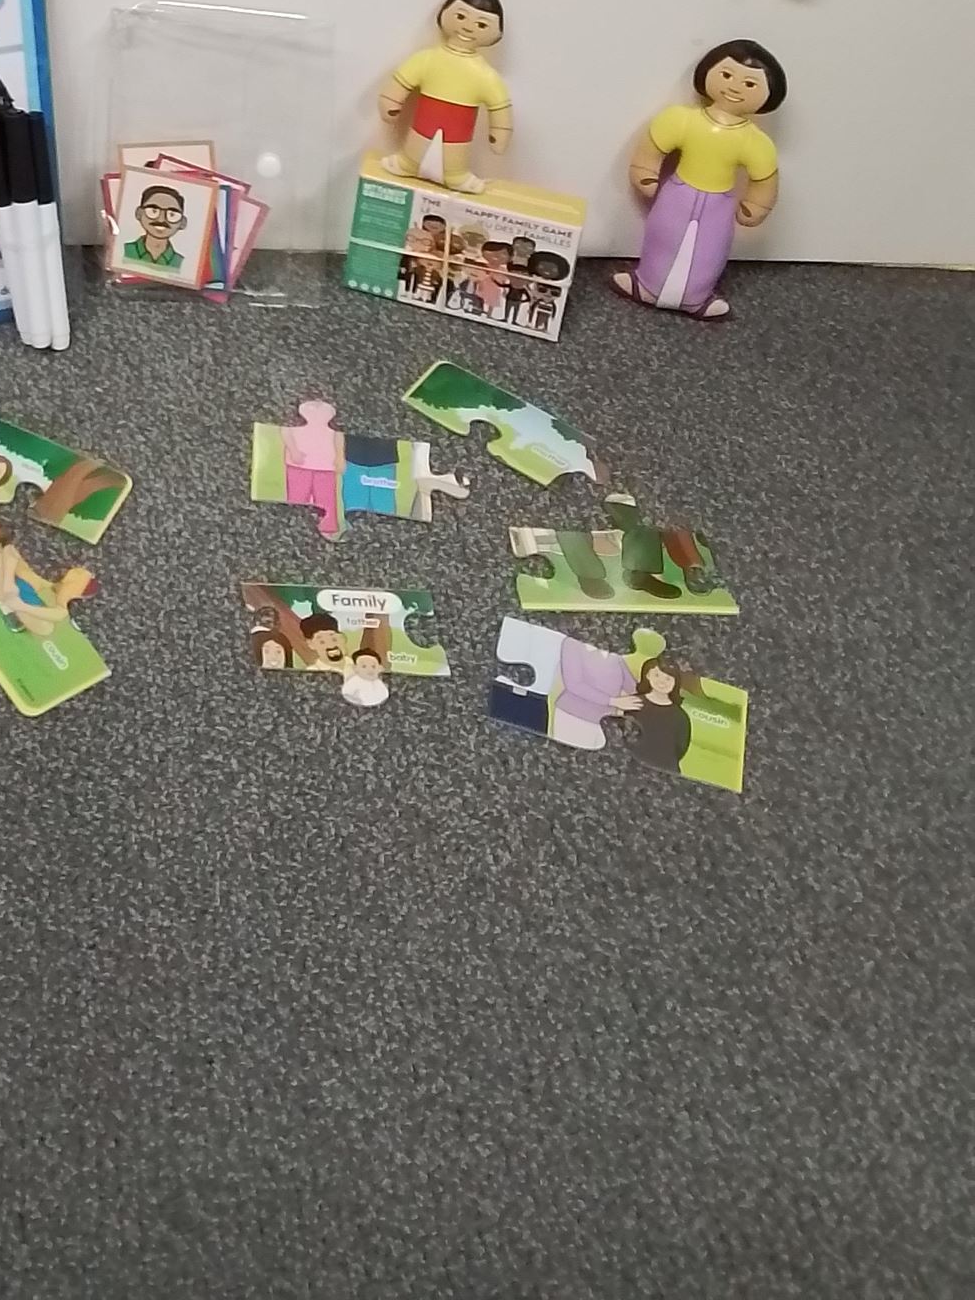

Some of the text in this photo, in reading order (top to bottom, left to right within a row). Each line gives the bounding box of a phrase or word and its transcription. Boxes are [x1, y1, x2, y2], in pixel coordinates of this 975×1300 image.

[422, 196, 442, 208] THE
[465, 207, 573, 239] HAPPY FAMILY GAME
[331, 593, 387, 612] Family
[389, 652, 416, 663] baby
[692, 710, 728, 726] cousin
